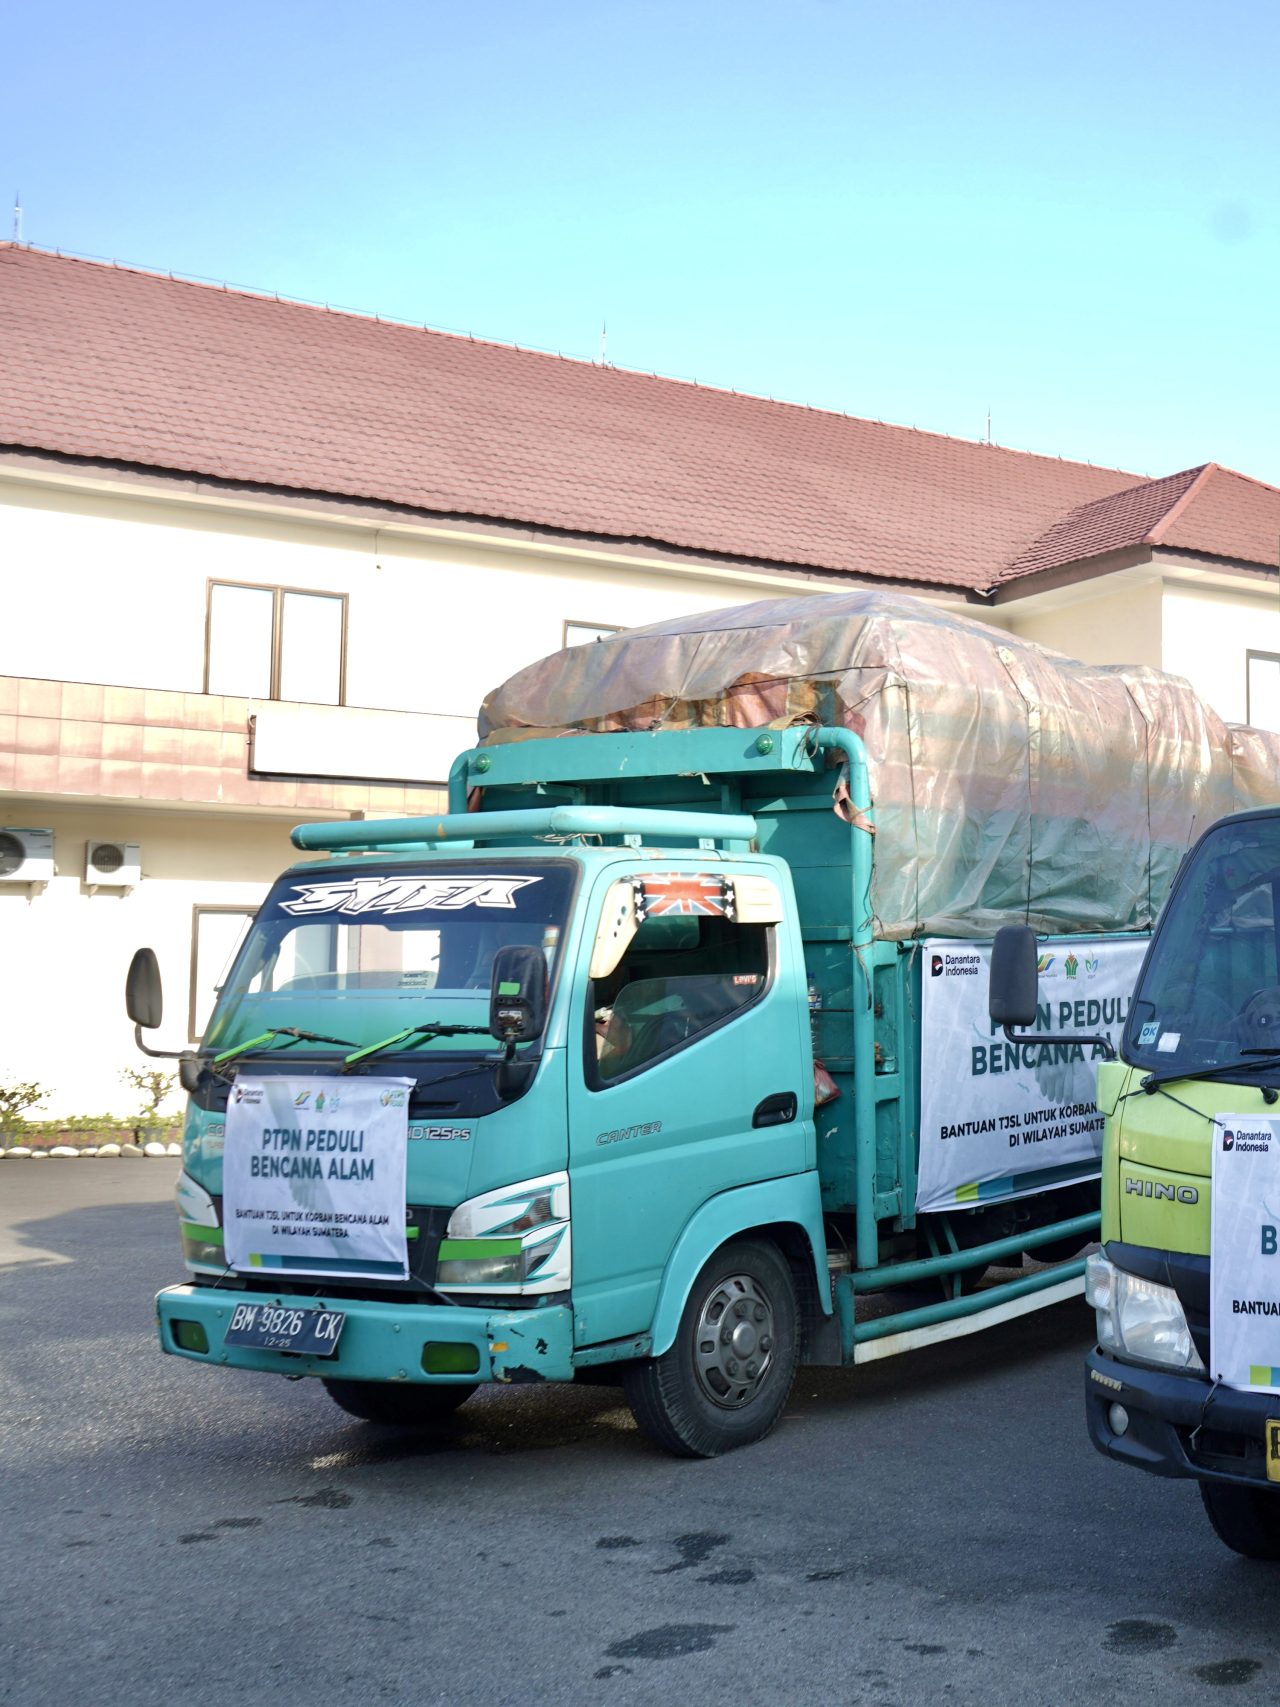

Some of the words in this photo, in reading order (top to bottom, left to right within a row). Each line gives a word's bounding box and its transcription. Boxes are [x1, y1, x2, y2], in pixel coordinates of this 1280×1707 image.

[945, 954, 981, 965] Danantara
[945, 965, 979, 976] Indonesia
[1142, 1027, 1157, 1037] OK
[972, 1041, 1085, 1076] BENCANA
[596, 1120, 663, 1146] CANTER
[940, 1117, 996, 1140] BANTUAN
[998, 1114, 1022, 1130] TJSL
[1023, 1108, 1057, 1126] UNTUK
[1059, 1101, 1098, 1120] KORBAN
[1009, 1134, 1020, 1148] DI
[1022, 1124, 1067, 1145] WILAYAH
[1069, 1117, 1105, 1136] SUMATE
[262, 1128, 302, 1151] PTPN
[306, 1129, 364, 1153] PEDULI
[1235, 1142, 1269, 1152] Indonesia
[1236, 1130, 1272, 1141] Danantara
[251, 1155, 323, 1180] BENCANA
[327, 1157, 375, 1181] ALAM
[1126, 1178, 1199, 1204] HINO
[235, 1208, 265, 1219] BANTUAN
[281, 1210, 303, 1221] UNTUK
[334, 1213, 368, 1225] BENCANA
[368, 1214, 390, 1225] ALAM
[272, 1225, 280, 1235] DI
[280, 1225, 312, 1237] WILAYAH
[312, 1226, 349, 1239] SUMATERA
[231, 1305, 259, 1332] BM
[259, 1307, 305, 1336] 9826
[314, 1313, 342, 1340] CK
